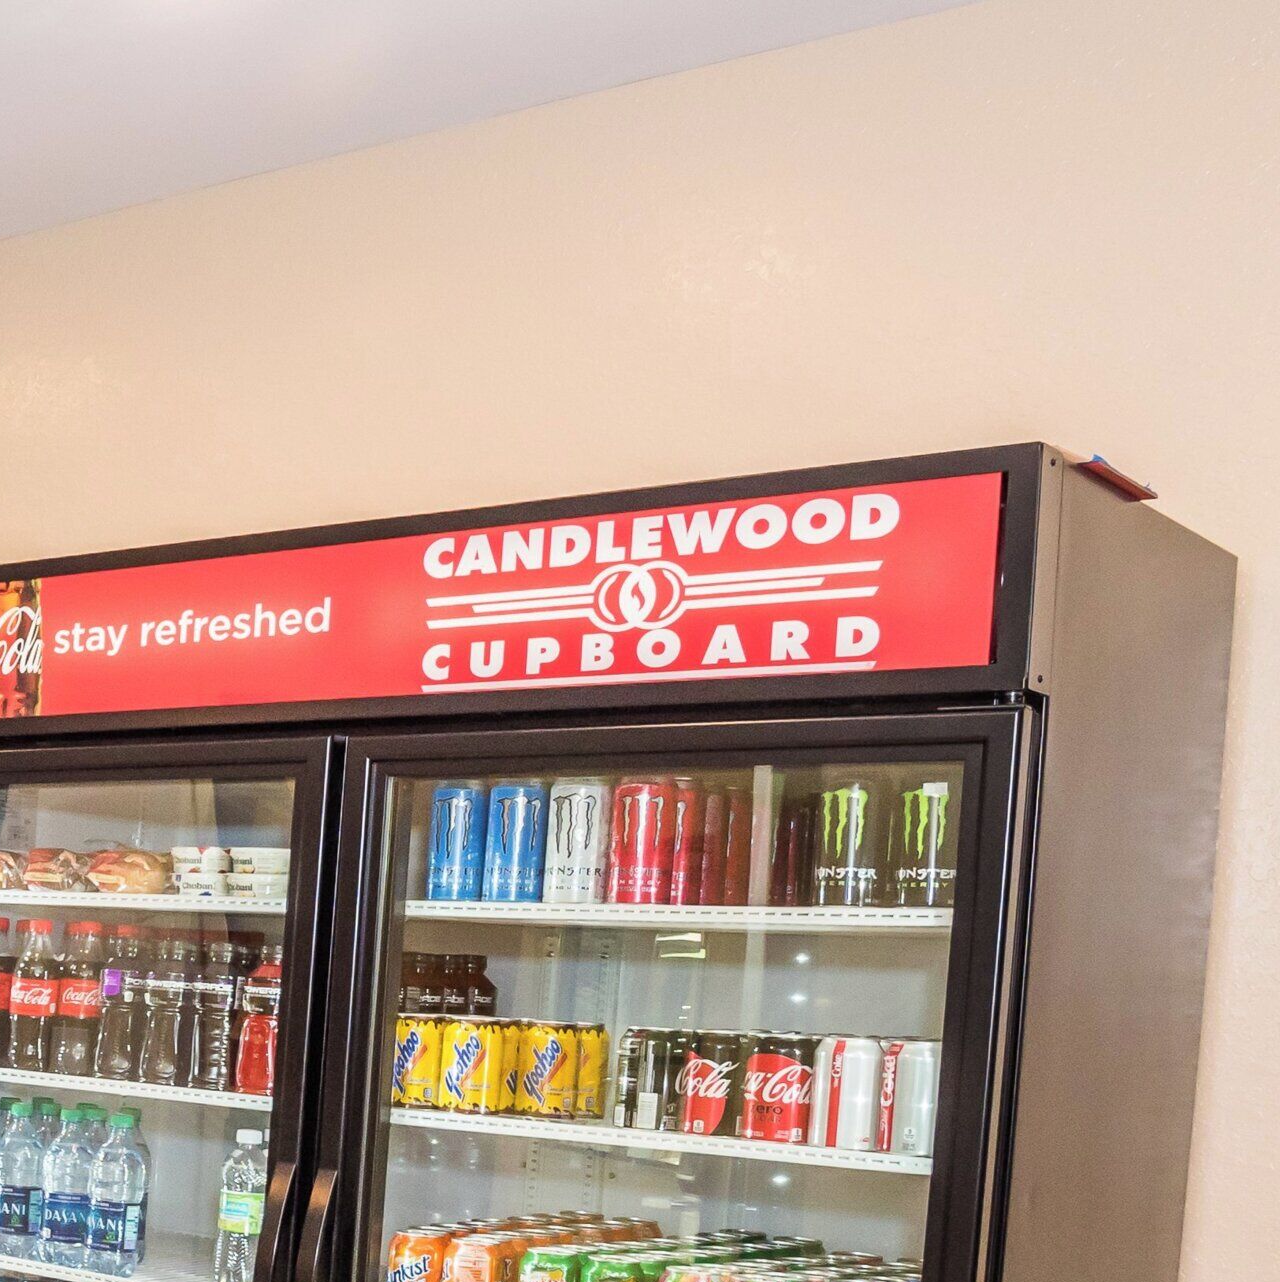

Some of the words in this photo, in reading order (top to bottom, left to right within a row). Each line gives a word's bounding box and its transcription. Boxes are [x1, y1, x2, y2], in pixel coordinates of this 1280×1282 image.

[423, 492, 903, 579] CANDLEWOOD
[53, 618, 130, 659] stay
[138, 596, 331, 648] refreshed
[422, 615, 881, 681] CUPBOARD
